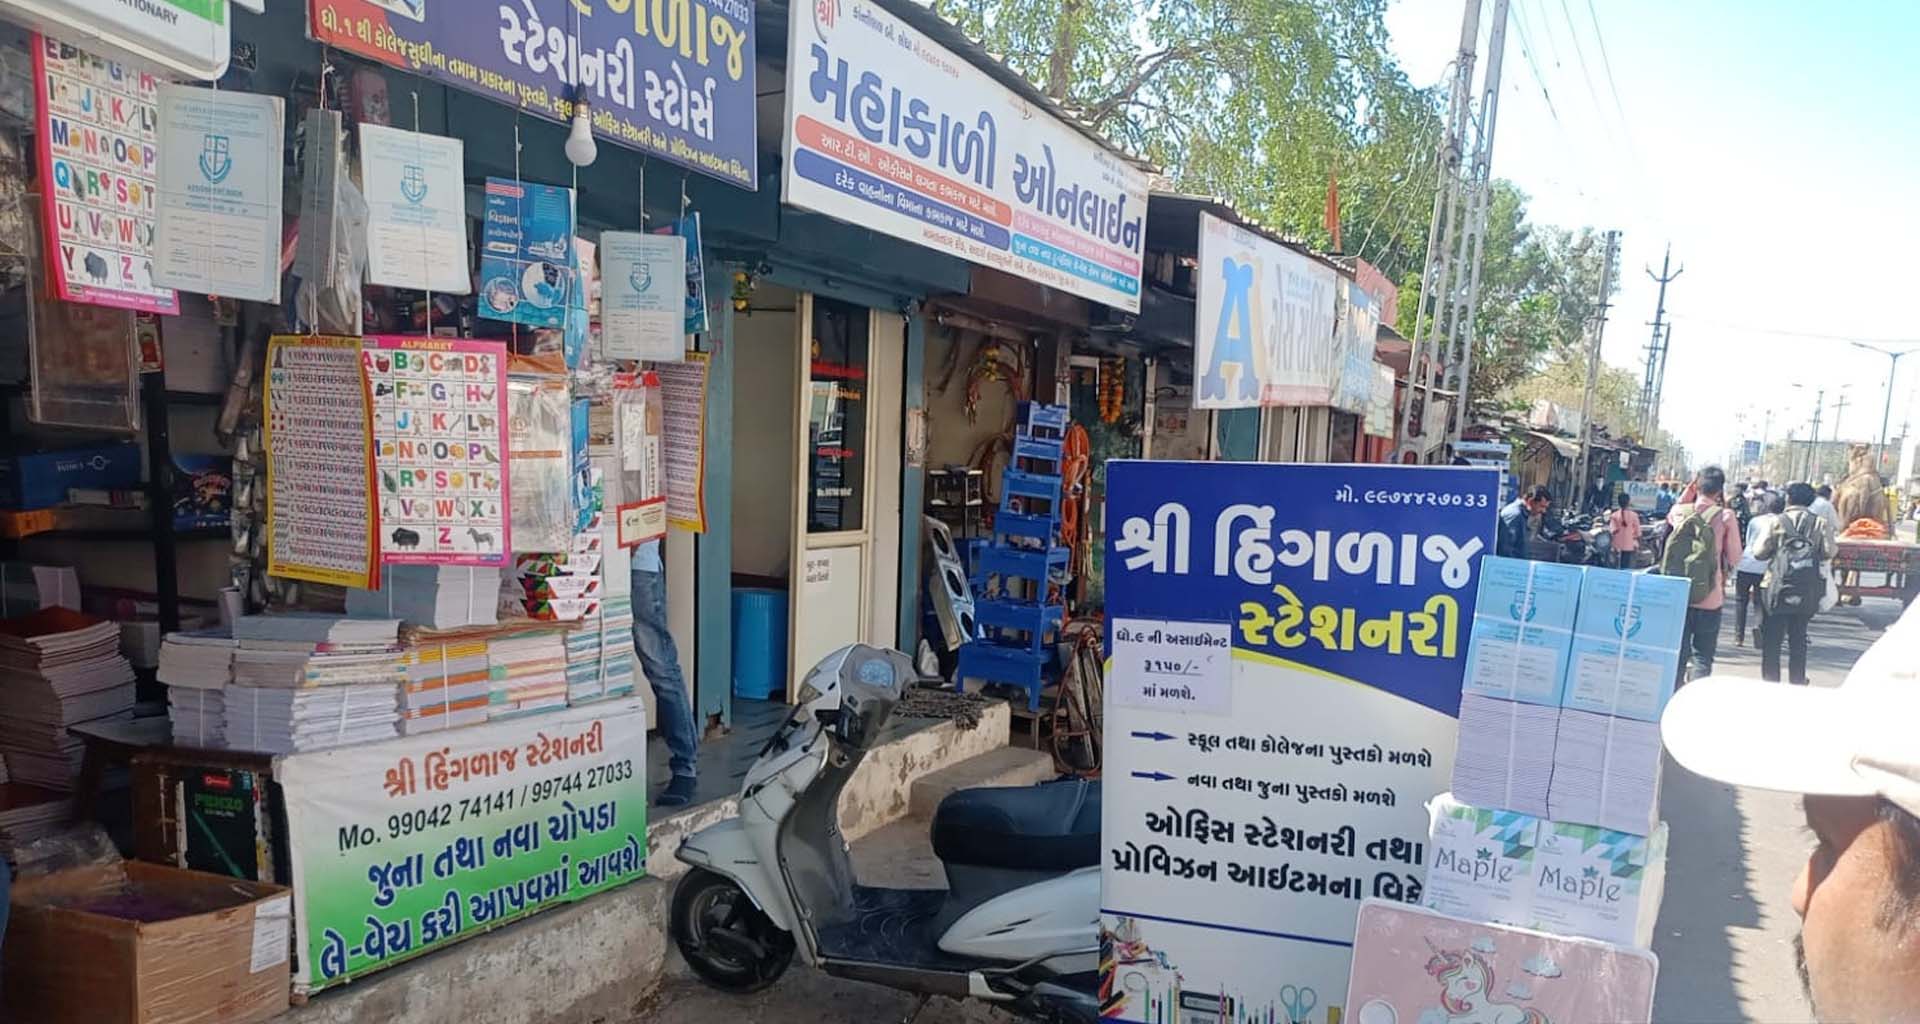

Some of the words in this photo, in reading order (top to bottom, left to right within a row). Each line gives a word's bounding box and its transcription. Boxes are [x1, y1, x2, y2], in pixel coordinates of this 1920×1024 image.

[448, 59, 478, 82] તમામ
[499, 3, 635, 110] સ્ટેશનરી
[645, 60, 717, 141] સ્ટોર્સ
[82, 88, 91, 112] J
[112, 97, 125, 123] K
[141, 106, 151, 131] L
[51, 118, 69, 146] M
[84, 128, 97, 155] N
[114, 138, 126, 162] O
[143, 146, 154, 169] P
[810, 43, 996, 190] મહાકાળી
[1013, 144, 1141, 254] ઓનલાઈન
[55, 161, 69, 189] Q
[87, 170, 99, 196] R
[117, 178, 128, 203] S
[144, 186, 154, 208] T
[835, 169, 855, 190] દરેક
[59, 204, 71, 229] U
[89, 212, 100, 236] V
[119, 219, 133, 243] W
[62, 246, 74, 270] Y
[122, 256, 133, 280] Z
[394, 352, 408, 369] B
[429, 353, 443, 371] C
[464, 356, 478, 372] D
[396, 382, 407, 399] F
[431, 383, 446, 401] G
[466, 384, 480, 401] H
[397, 412, 410, 429] J
[432, 414, 446, 431] K
[468, 414, 479, 431] L
[399, 441, 413, 458] N
[433, 442, 448, 459] O
[469, 443, 481, 460] P
[400, 470, 414, 488] R
[435, 471, 448, 488] S
[469, 472, 481, 489] T
[1336, 487, 1358, 504] મો.
[1364, 489, 1488, 508] ૯૯૭૪૪૨૭૦૩૩
[401, 499, 414, 516] V
[435, 500, 454, 517] W
[471, 500, 484, 517] X
[438, 527, 452, 544] Z
[1114, 502, 1191, 575] શ્રી
[1214, 504, 1484, 589] હિંગળાજ
[1148, 630, 1162, 644] ની
[1239, 584, 1459, 658] સ્ટેશનરી
[1143, 683, 1156, 697] માં
[1160, 684, 1196, 701] મળશે.
[383, 757, 416, 798] શ્રી
[424, 747, 518, 792] હિંગળાજ
[526, 720, 604, 768] સ્ટેશનરી
[1187, 732, 1220, 753] સ્કૂલ
[1225, 735, 1256, 752] તથા
[1260, 735, 1324, 758] કોલેજના
[1329, 744, 1383, 765] પુસ્તકો
[1388, 748, 1432, 768] મળશે
[339, 824, 381, 852] Mo.
[388, 803, 451, 839] 99042
[459, 789, 514, 822] 74141
[532, 772, 583, 803] 99744
[587, 760, 633, 789] 27033
[1187, 774, 1217, 789] નવા
[1222, 776, 1252, 793] તથા
[1257, 780, 1290, 799] જુના
[1295, 783, 1347, 804] પુસ્તકો
[1353, 788, 1396, 807] મળશે
[368, 854, 423, 906] જુના
[433, 837, 485, 879] તથા
[492, 821, 539, 858] નવા
[549, 800, 616, 843] ચોપડા
[1146, 805, 1234, 845] ઓફિસ
[1244, 816, 1355, 858] સ્ટેશનરી
[1366, 837, 1422, 865] તથા
[1112, 841, 1217, 882] પ્રોવિઝન
[1227, 860, 1361, 900] આઈટમના
[1435, 848, 1513, 883] Maple
[1539, 865, 1621, 903] Maple
[321, 916, 411, 978] લે-વેચ
[422, 890, 461, 944] કરી
[471, 855, 569, 921] આપવમાં
[578, 840, 649, 885] આવશે.
